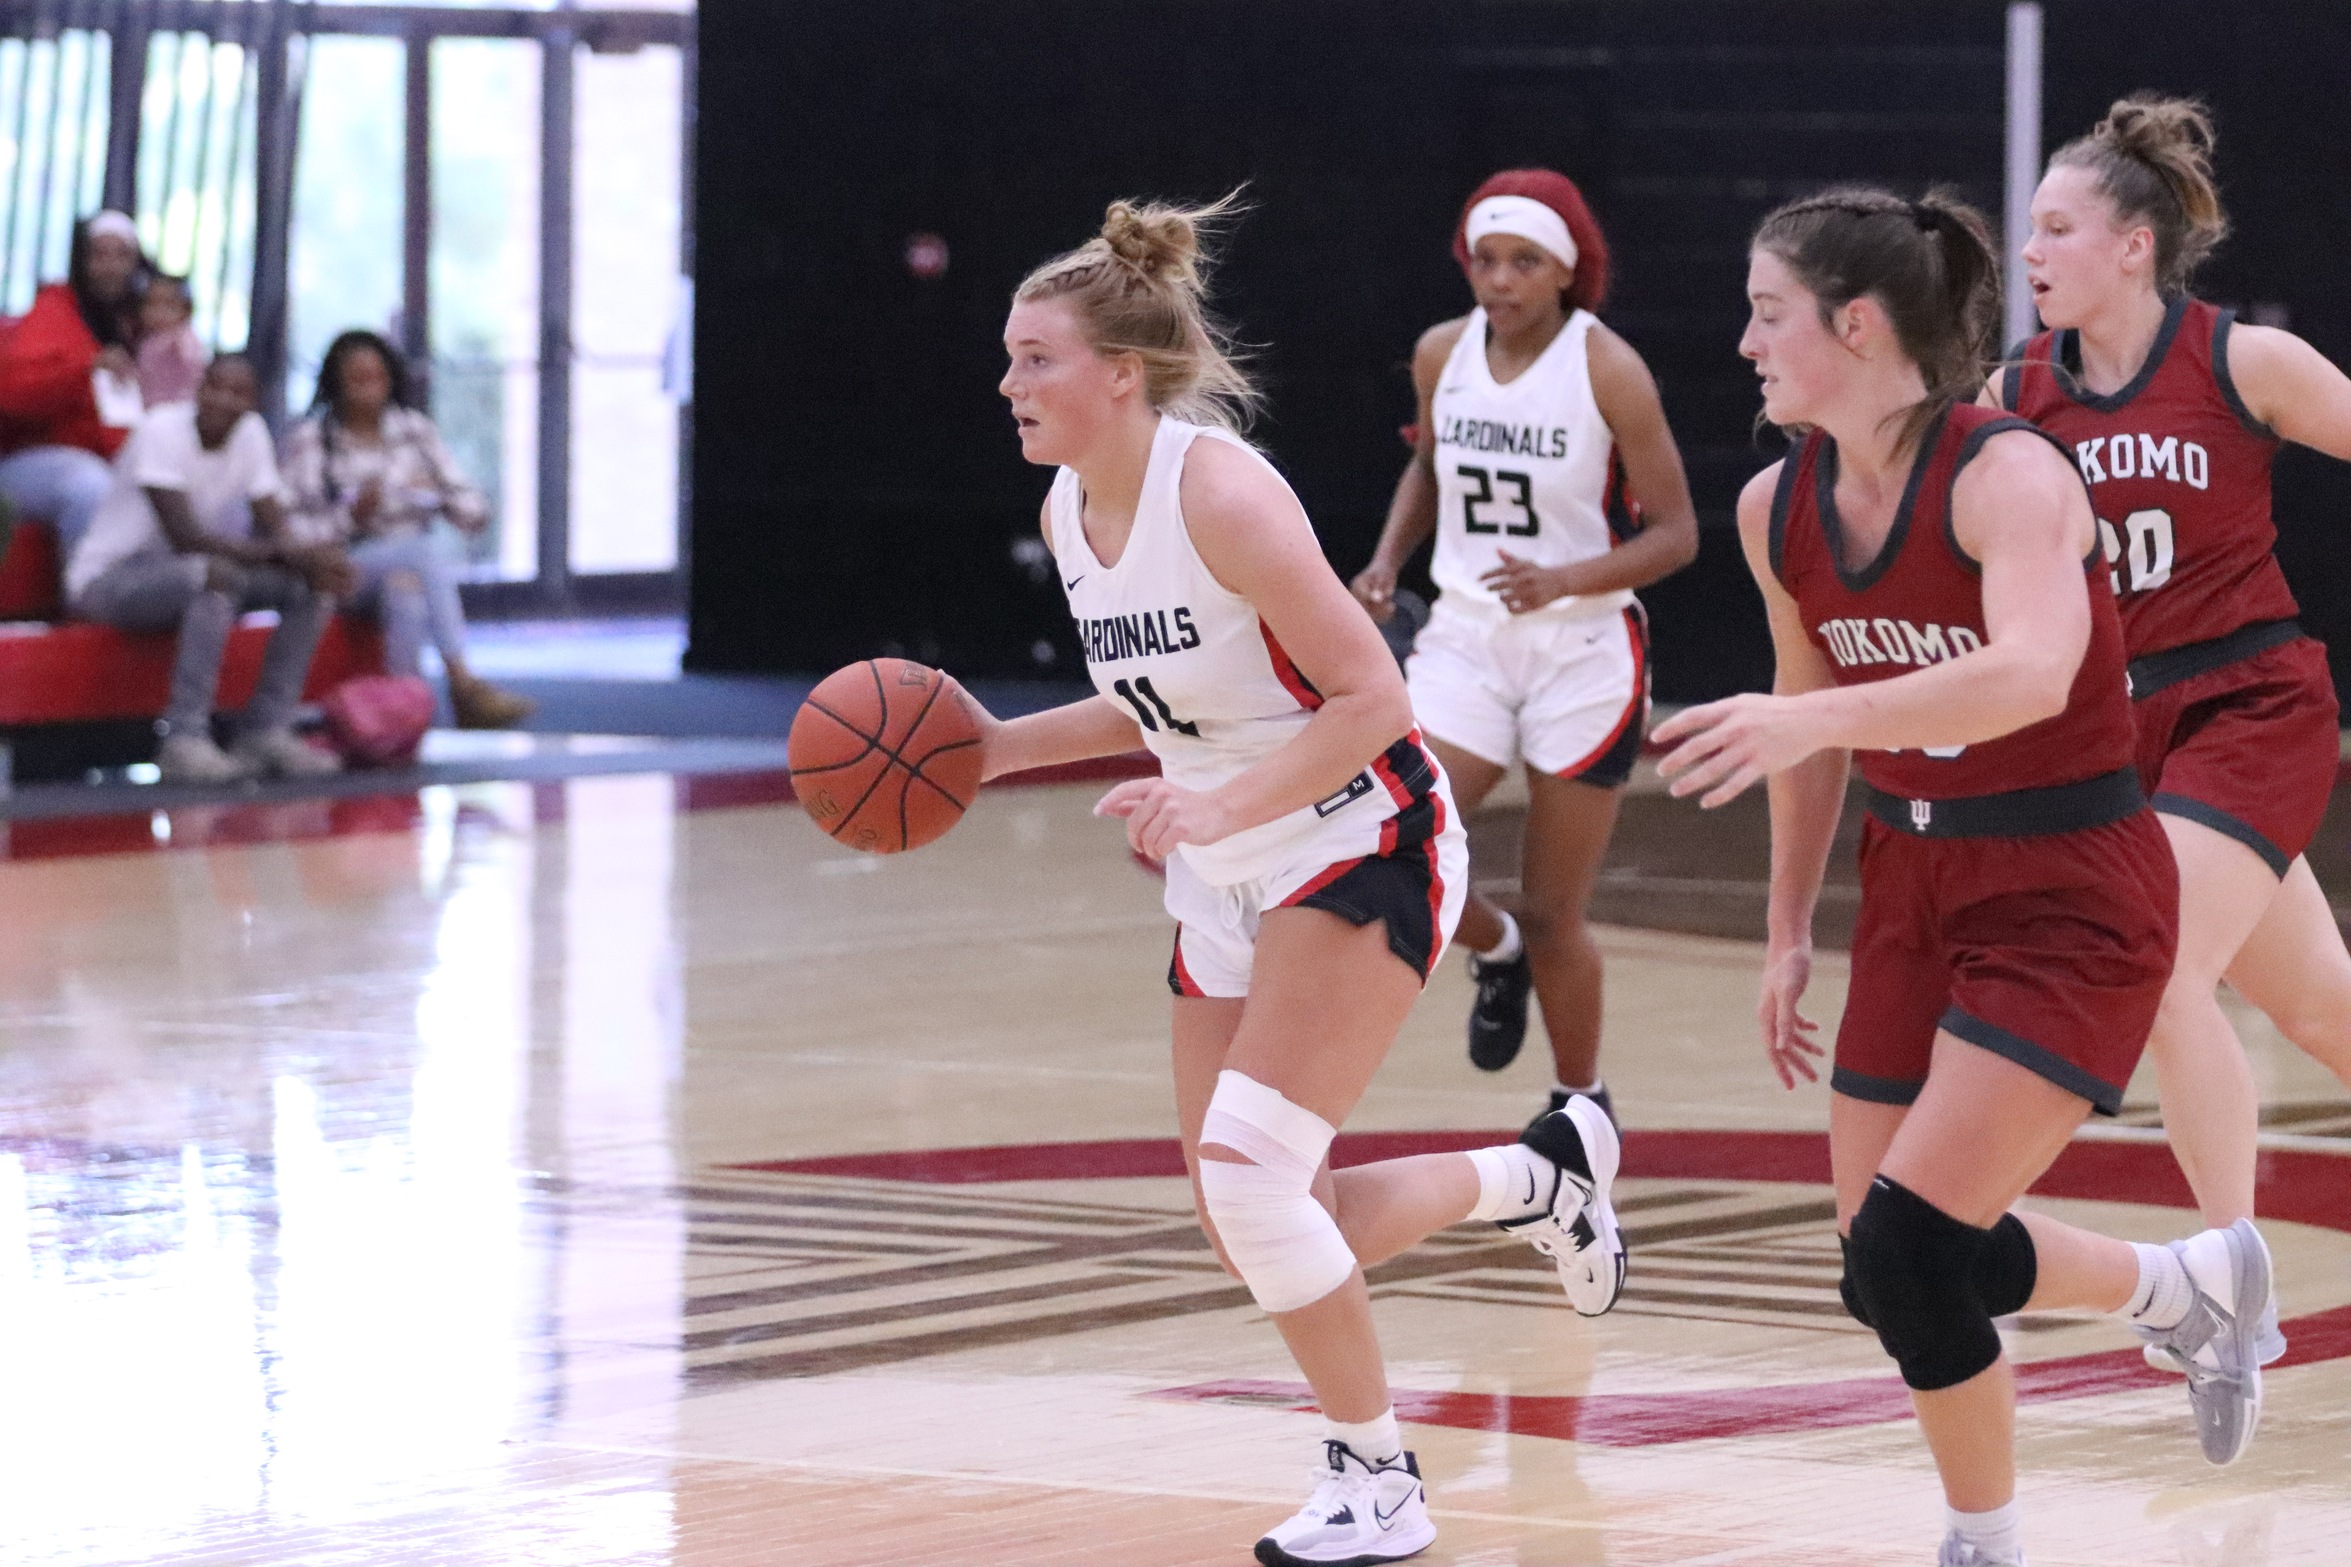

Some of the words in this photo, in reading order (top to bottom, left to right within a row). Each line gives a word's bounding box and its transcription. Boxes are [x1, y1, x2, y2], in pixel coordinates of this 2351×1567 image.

[1457, 465, 1540, 537] 23
[1114, 676, 1201, 738] 11
[1352, 779, 1365, 791] M
